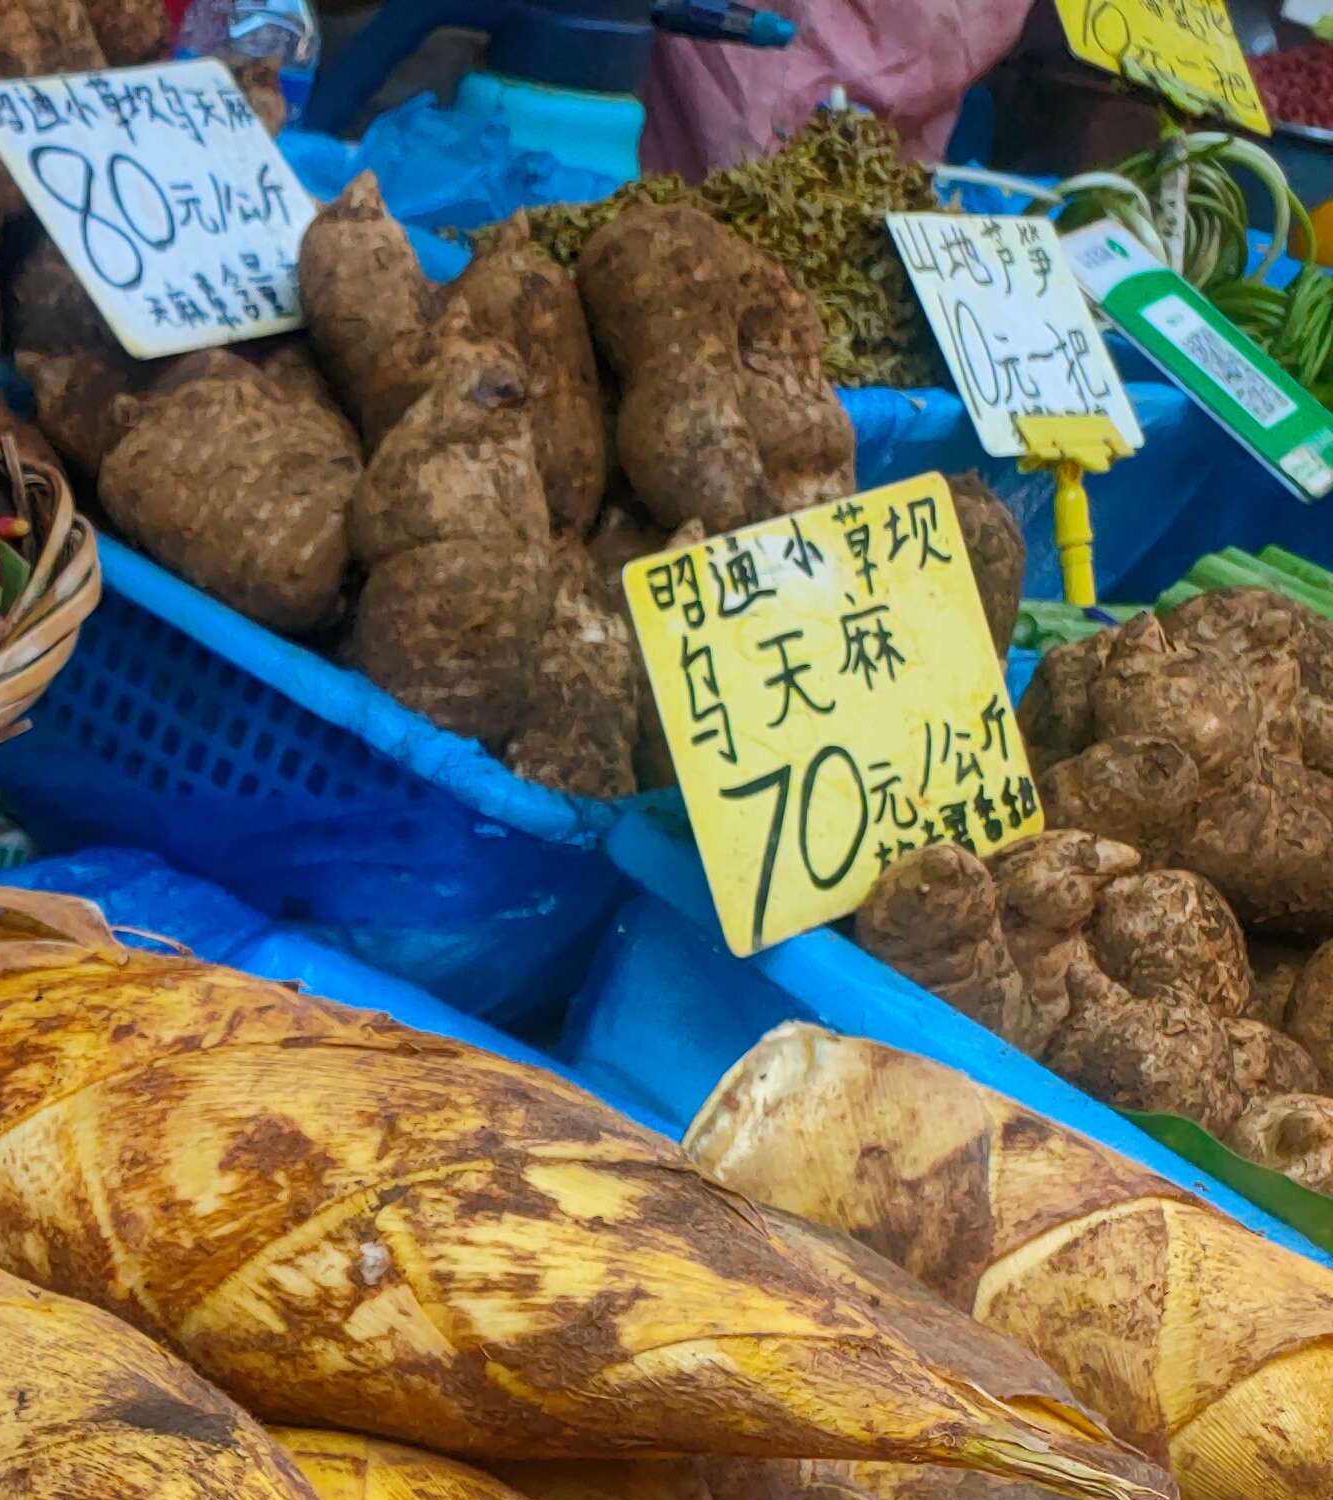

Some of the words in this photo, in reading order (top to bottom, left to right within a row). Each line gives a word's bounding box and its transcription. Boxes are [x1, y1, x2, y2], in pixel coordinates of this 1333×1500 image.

[646, 497, 952, 630] 昭通小草坝
[680, 593, 905, 765] 乌天麻
[718, 693, 1008, 950] 70元/公斤
